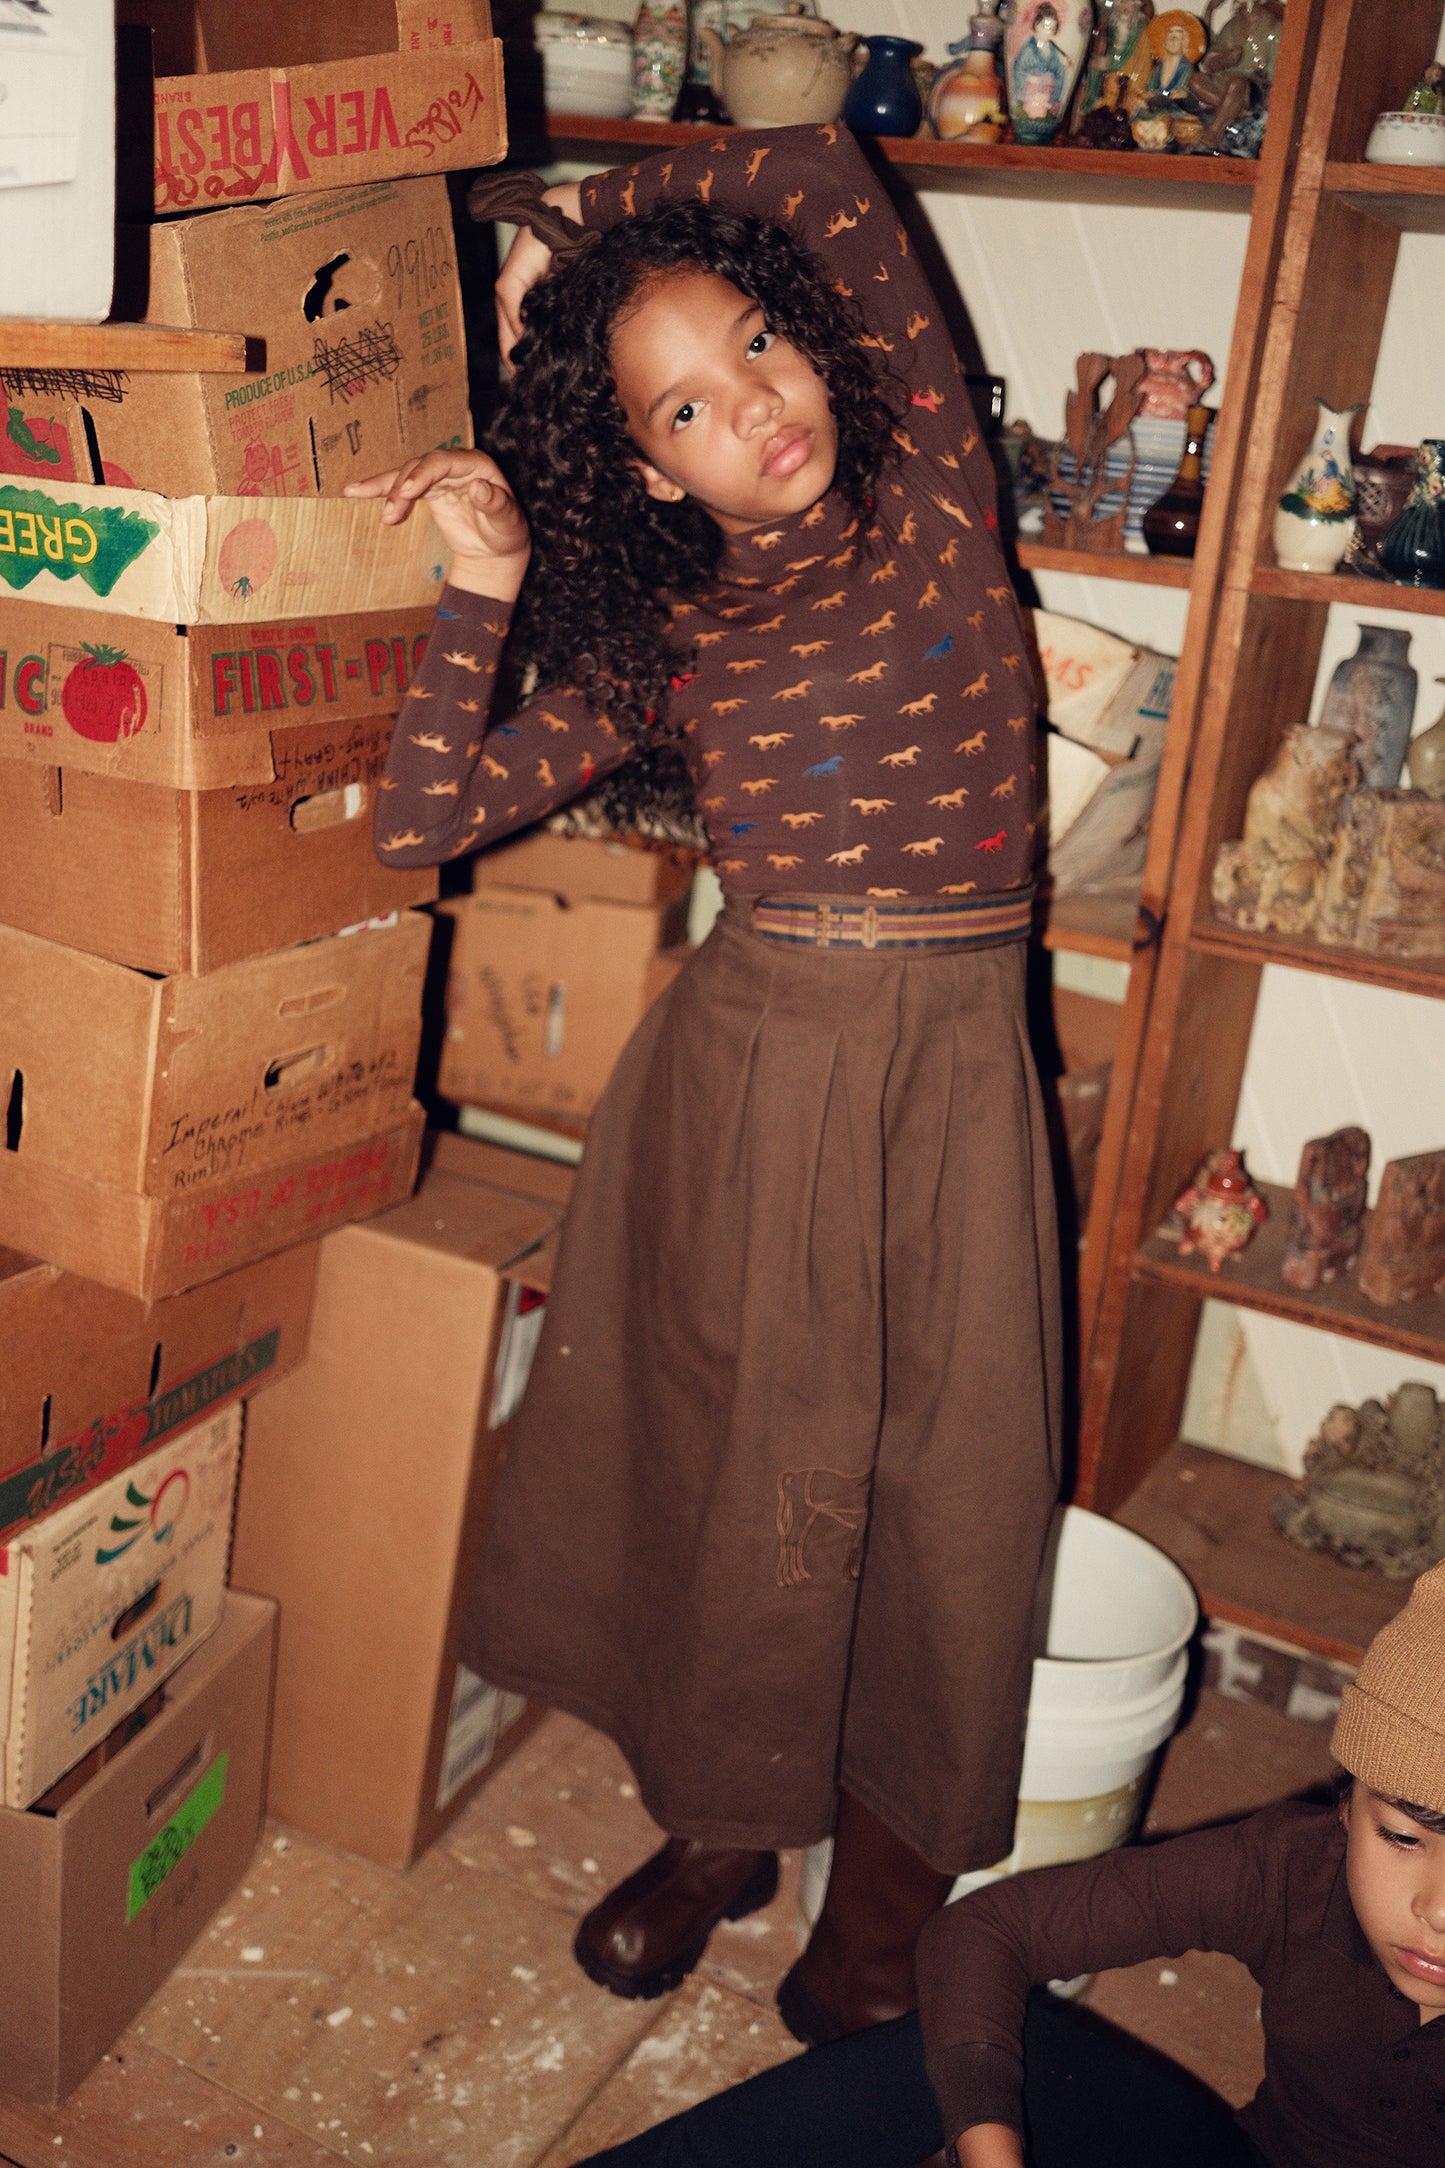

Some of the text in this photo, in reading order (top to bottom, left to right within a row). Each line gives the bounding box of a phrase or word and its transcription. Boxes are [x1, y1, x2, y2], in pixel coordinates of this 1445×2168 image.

[154, 81, 400, 184] VERY BEST
[225, 376, 273, 411] PRODUCE
[273, 371, 289, 395] OF
[228, 392, 295, 428] PROTECT FRESH
[231, 417, 265, 443] TOMATO
[24, 722, 54, 738] BRAND
